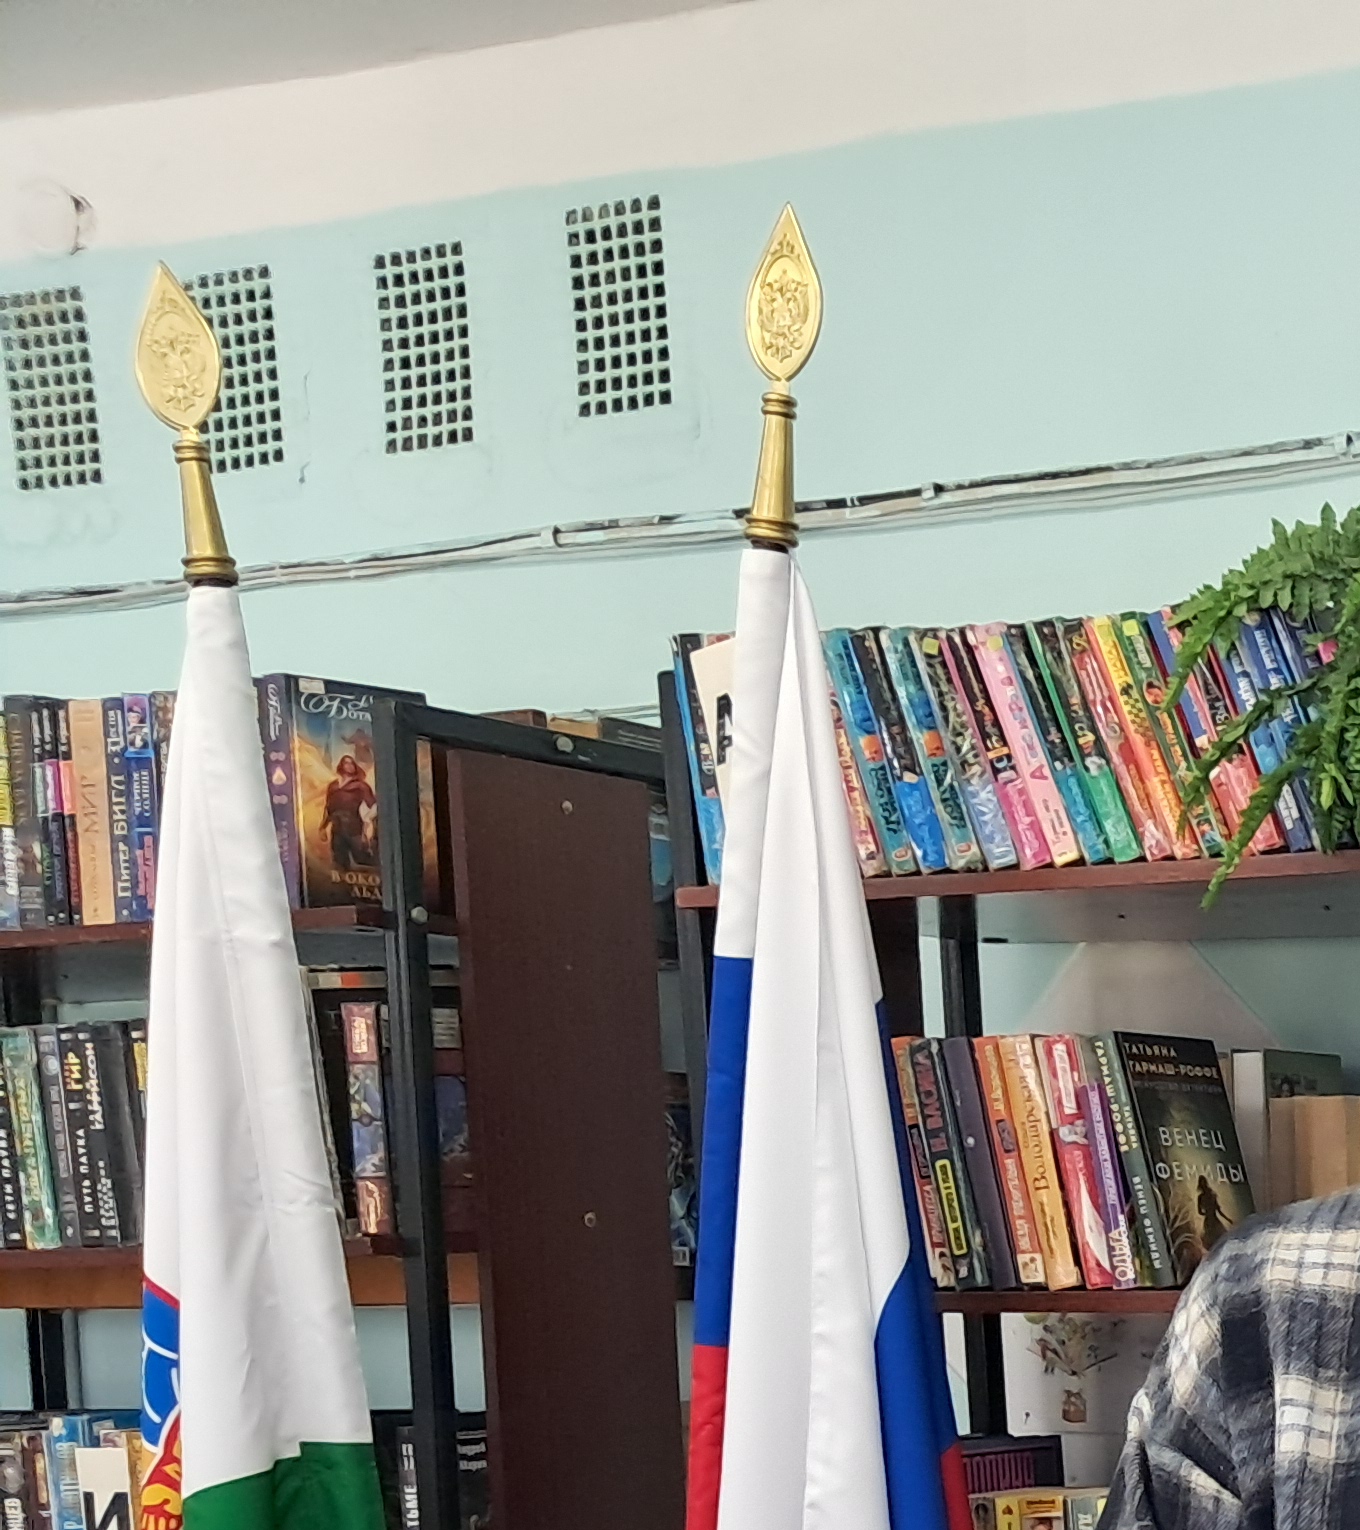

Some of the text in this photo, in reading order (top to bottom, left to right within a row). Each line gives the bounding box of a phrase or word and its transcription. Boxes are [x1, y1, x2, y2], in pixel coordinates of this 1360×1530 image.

[80, 776, 101, 835] МИР
[110, 774, 132, 898] Питер БИГЛ
[1123, 1042, 1178, 1058] ТАТЬЯНА
[1128, 1060, 1219, 1079] ГАРМАШ-РОФФЕ
[1093, 1040, 1130, 1154] ГАРМАШ-РОФФЕ
[1018, 1074, 1050, 1192] Володарская
[1122, 1105, 1139, 1150] ТАТЬЯНА
[1159, 1126, 1227, 1152] ВЕНЕЦ
[75, 1128, 95, 1214] ПУТЬ ПАУКА
[1155, 1161, 1245, 1183] ФЕМИДЫ
[1132, 1176, 1162, 1270] ВЕНЕЦ ФЕМИДЫ
[1108, 1227, 1131, 1282] ОЛЬГА
[403, 1485, 419, 1528] ТЬМЕ
